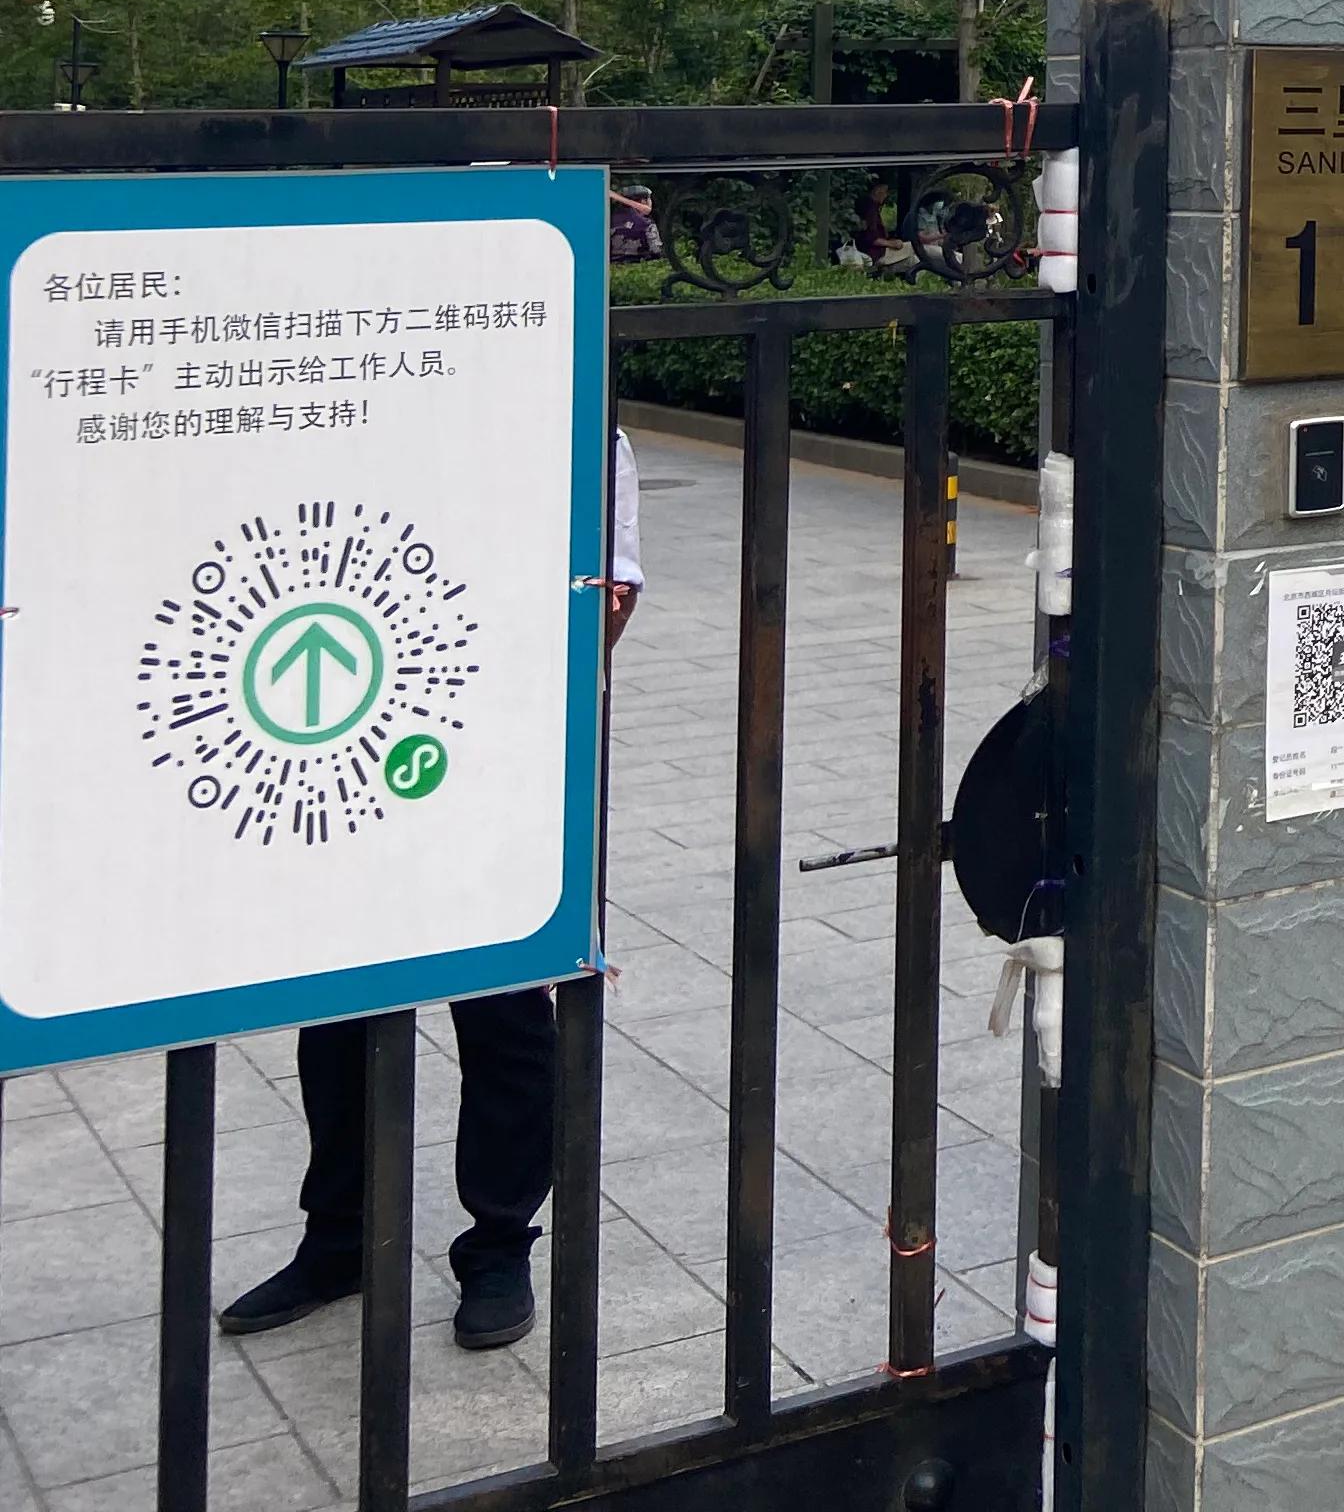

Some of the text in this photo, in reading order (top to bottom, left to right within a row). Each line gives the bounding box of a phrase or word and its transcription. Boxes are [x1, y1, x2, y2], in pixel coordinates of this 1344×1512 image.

[44, 272, 182, 303] 各位居民：
[95, 301, 548, 348] 请用手机微信扫描下方二维码获得
[76, 400, 369, 445] 感谢您的理解与支持！
